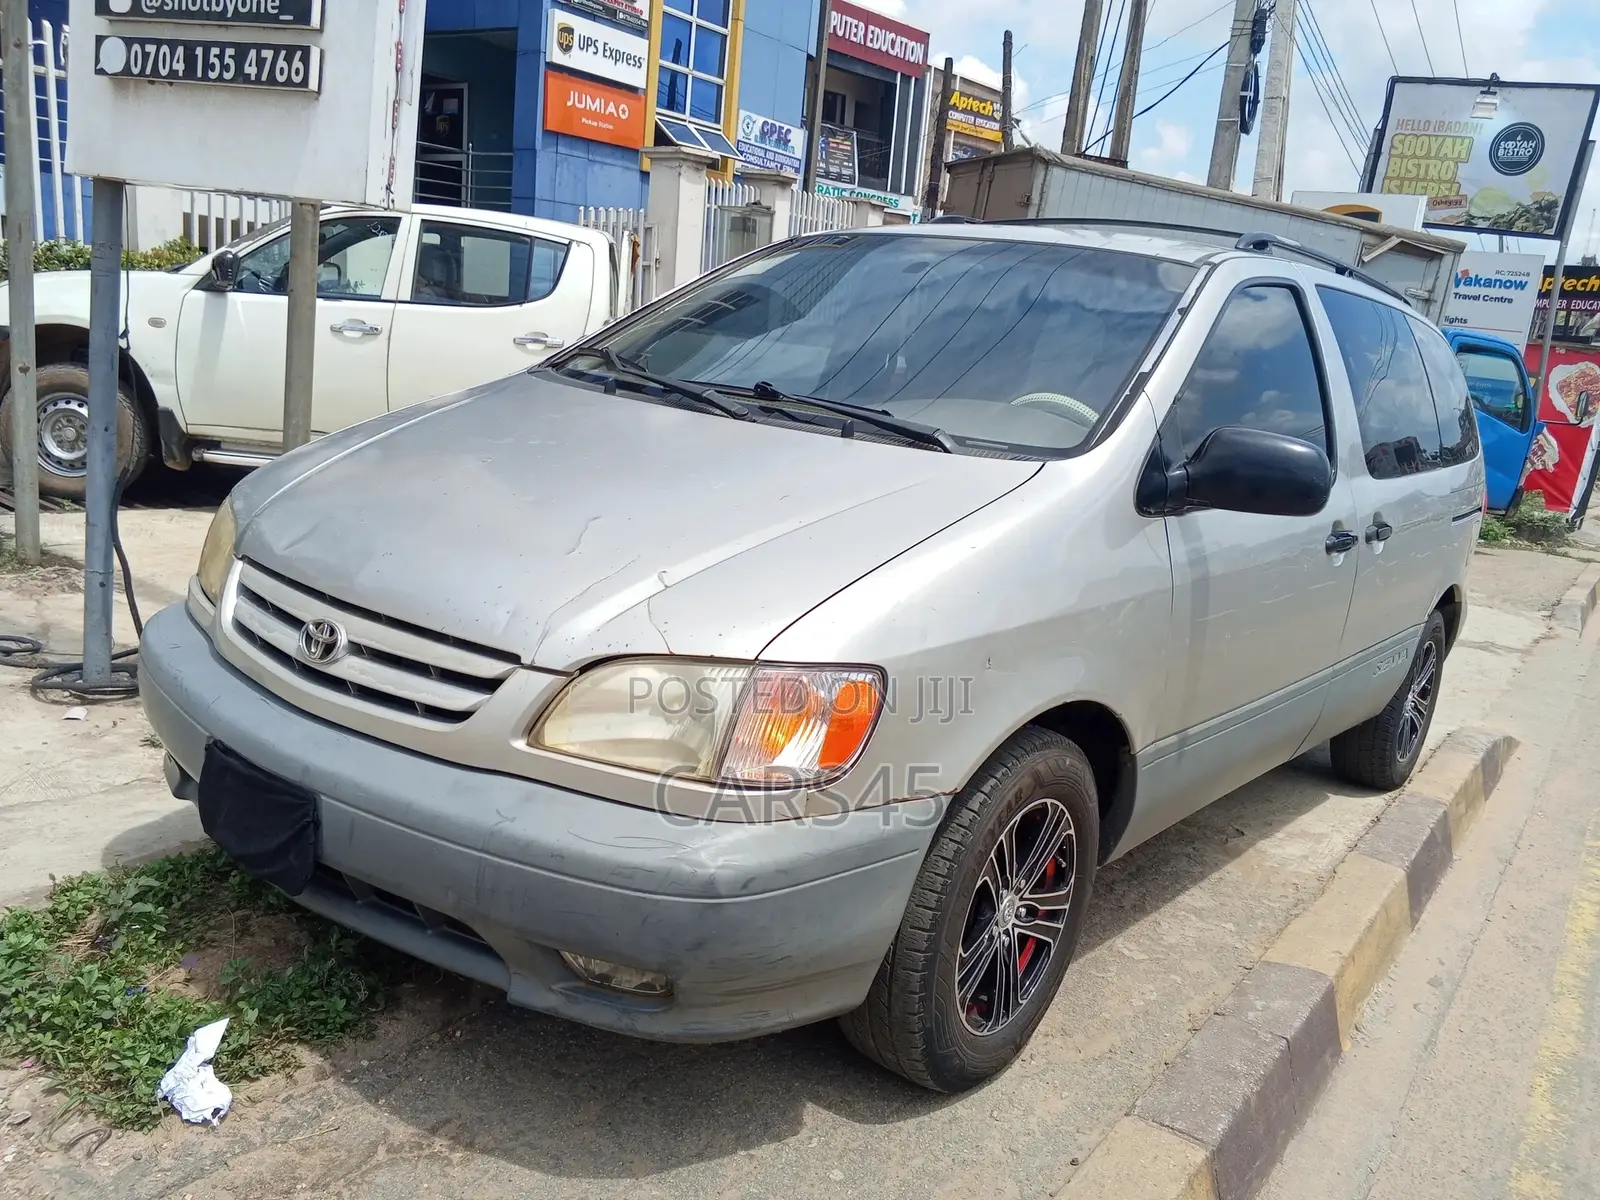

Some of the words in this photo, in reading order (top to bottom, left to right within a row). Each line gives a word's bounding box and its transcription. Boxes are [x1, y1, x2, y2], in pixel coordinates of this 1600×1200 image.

[559, 31, 573, 48] ups
[830, 11, 865, 45] PUTER
[866, 25, 925, 65] EDUCATION
[578, 33, 599, 55] UPS
[602, 42, 643, 69] Express
[130, 43, 185, 77] 0704
[195, 46, 236, 81] 155
[244, 48, 305, 84] 4766
[566, 90, 618, 118] JUMIA
[949, 91, 993, 116] Aptech
[1396, 119, 1430, 132] HELLO
[1391, 134, 1471, 160] SOOYAH
[1498, 148, 1533, 157] BISTRO
[1499, 140, 1536, 149] SOOYAH
[1387, 157, 1456, 181] BISTRO
[1453, 292, 1481, 301] Travel
[1482, 295, 1514, 304] Centre
